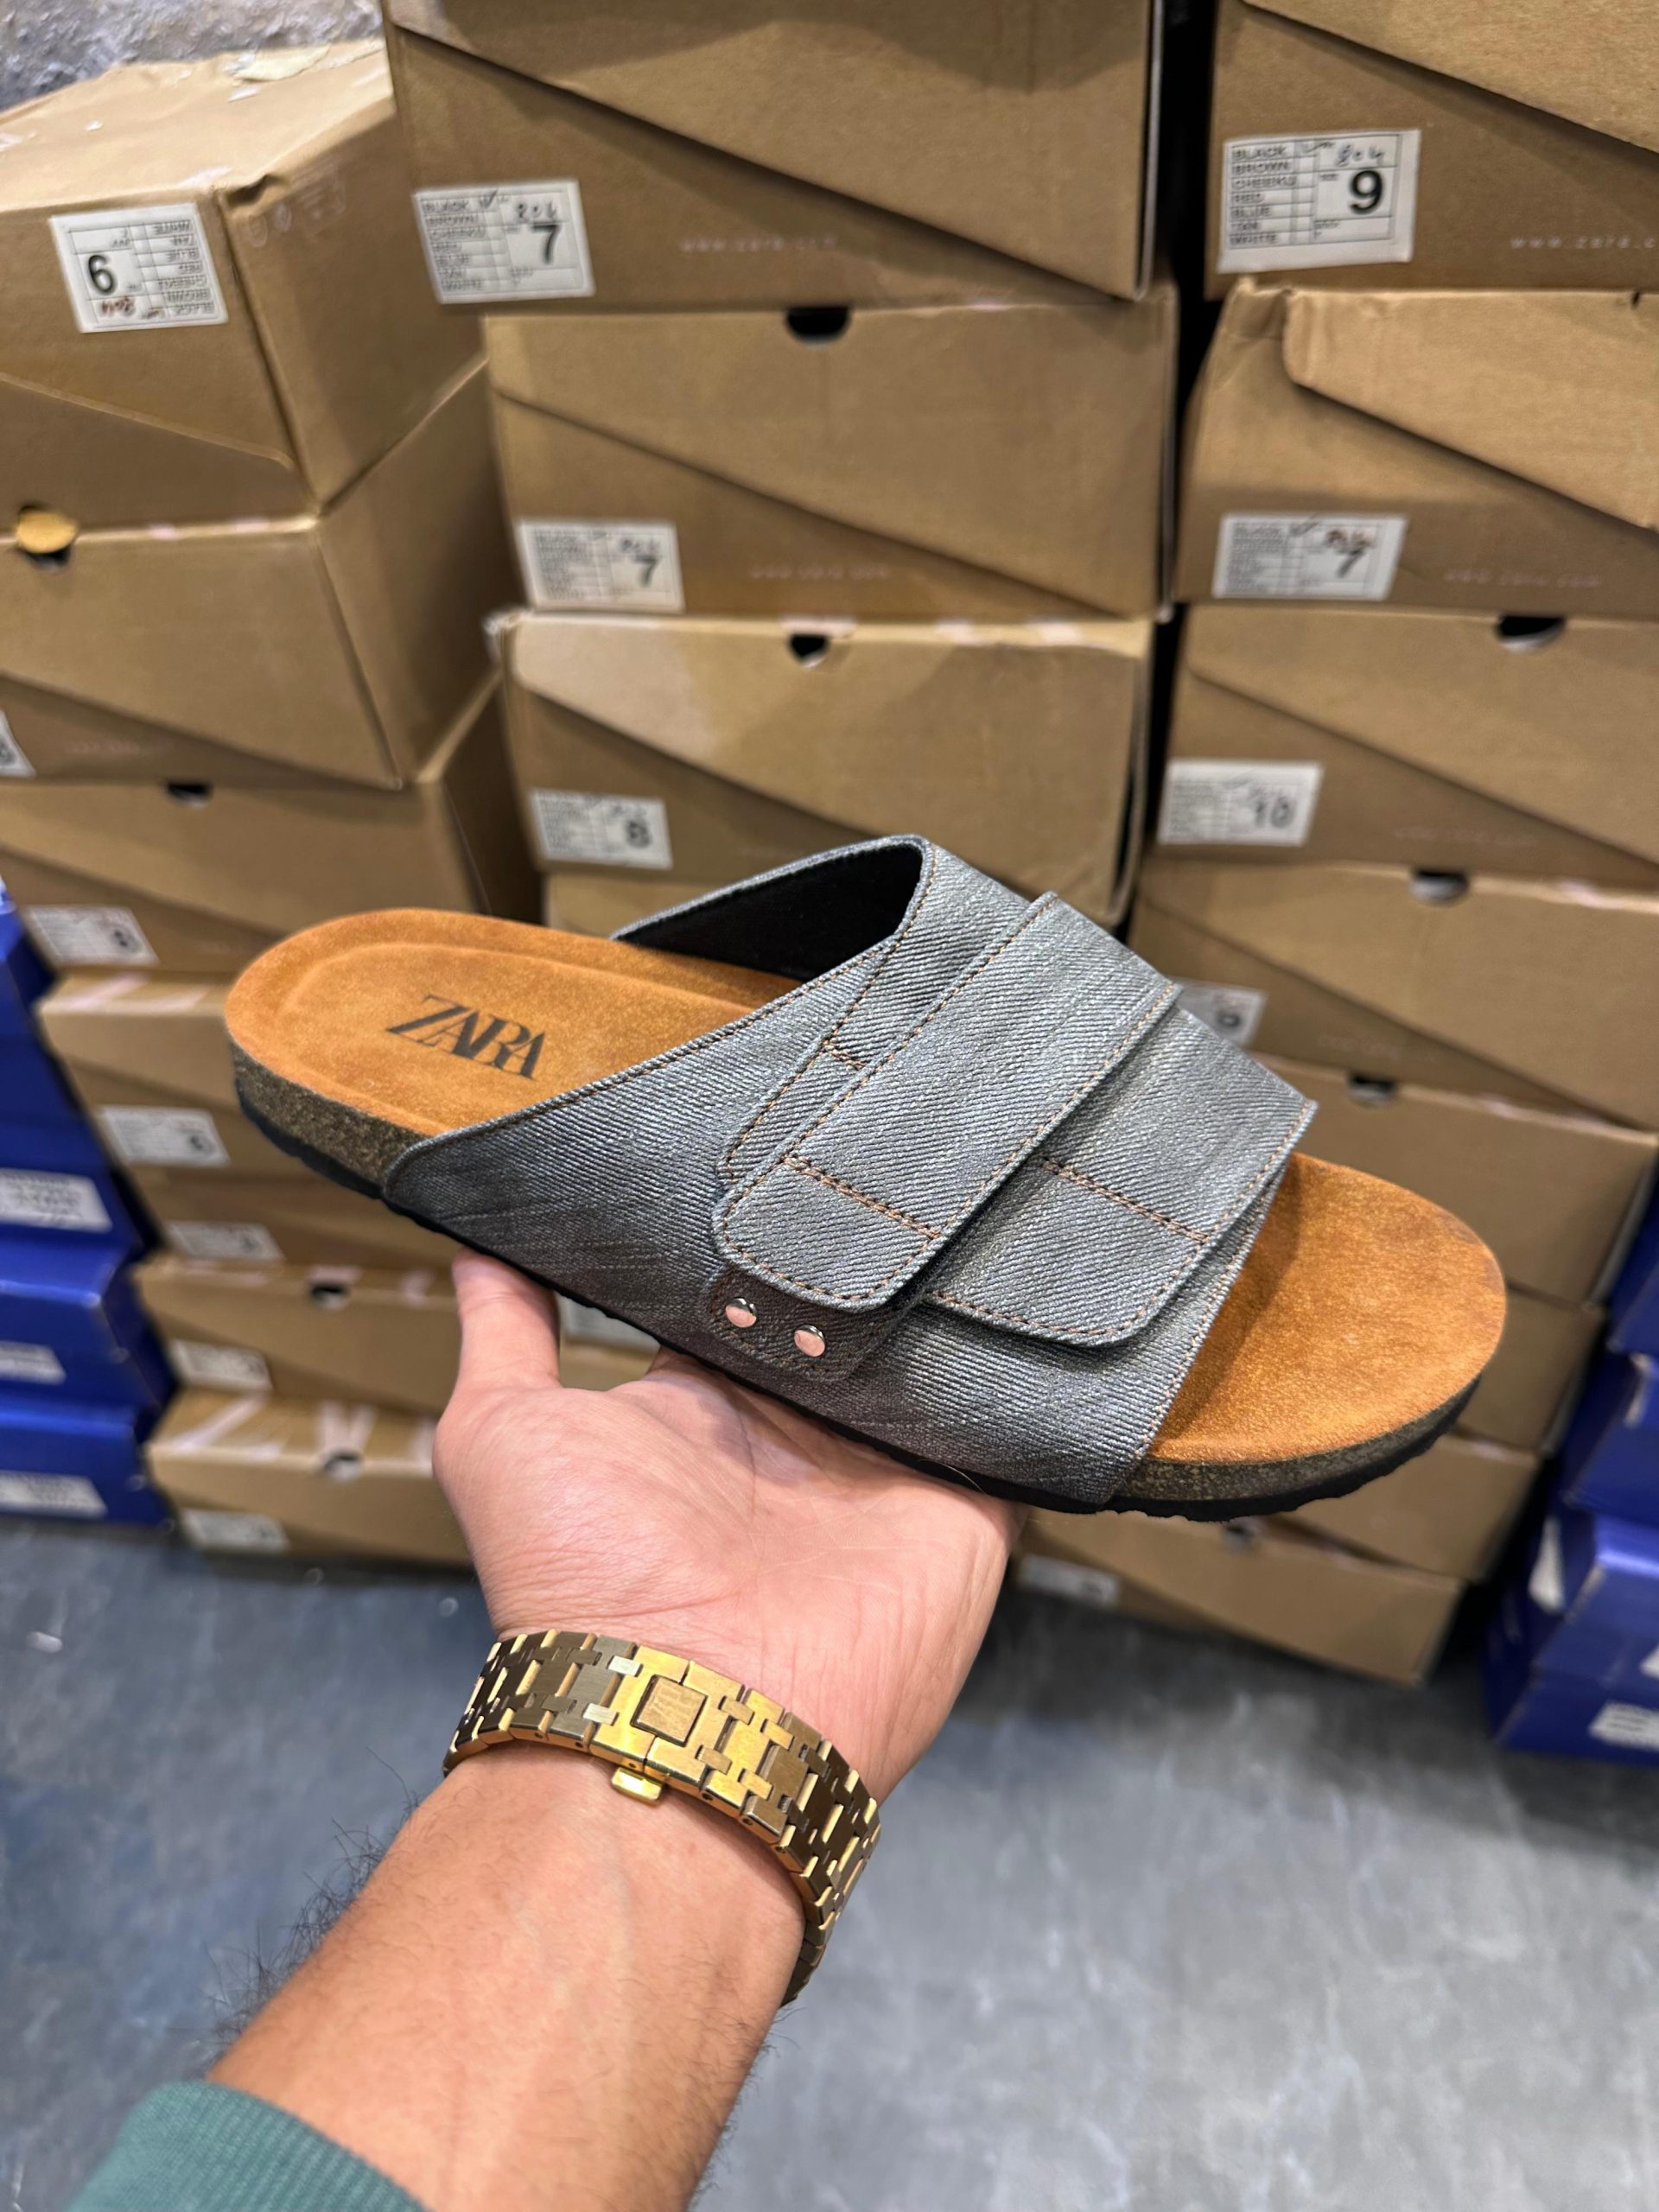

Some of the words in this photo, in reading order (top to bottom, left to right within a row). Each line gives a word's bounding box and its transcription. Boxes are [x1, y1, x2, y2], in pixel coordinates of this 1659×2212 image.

[1349, 168, 1385, 215] 9
[531, 223, 562, 264] 7
[634, 554, 659, 589] 7
[385, 994, 546, 1080] ZARA
